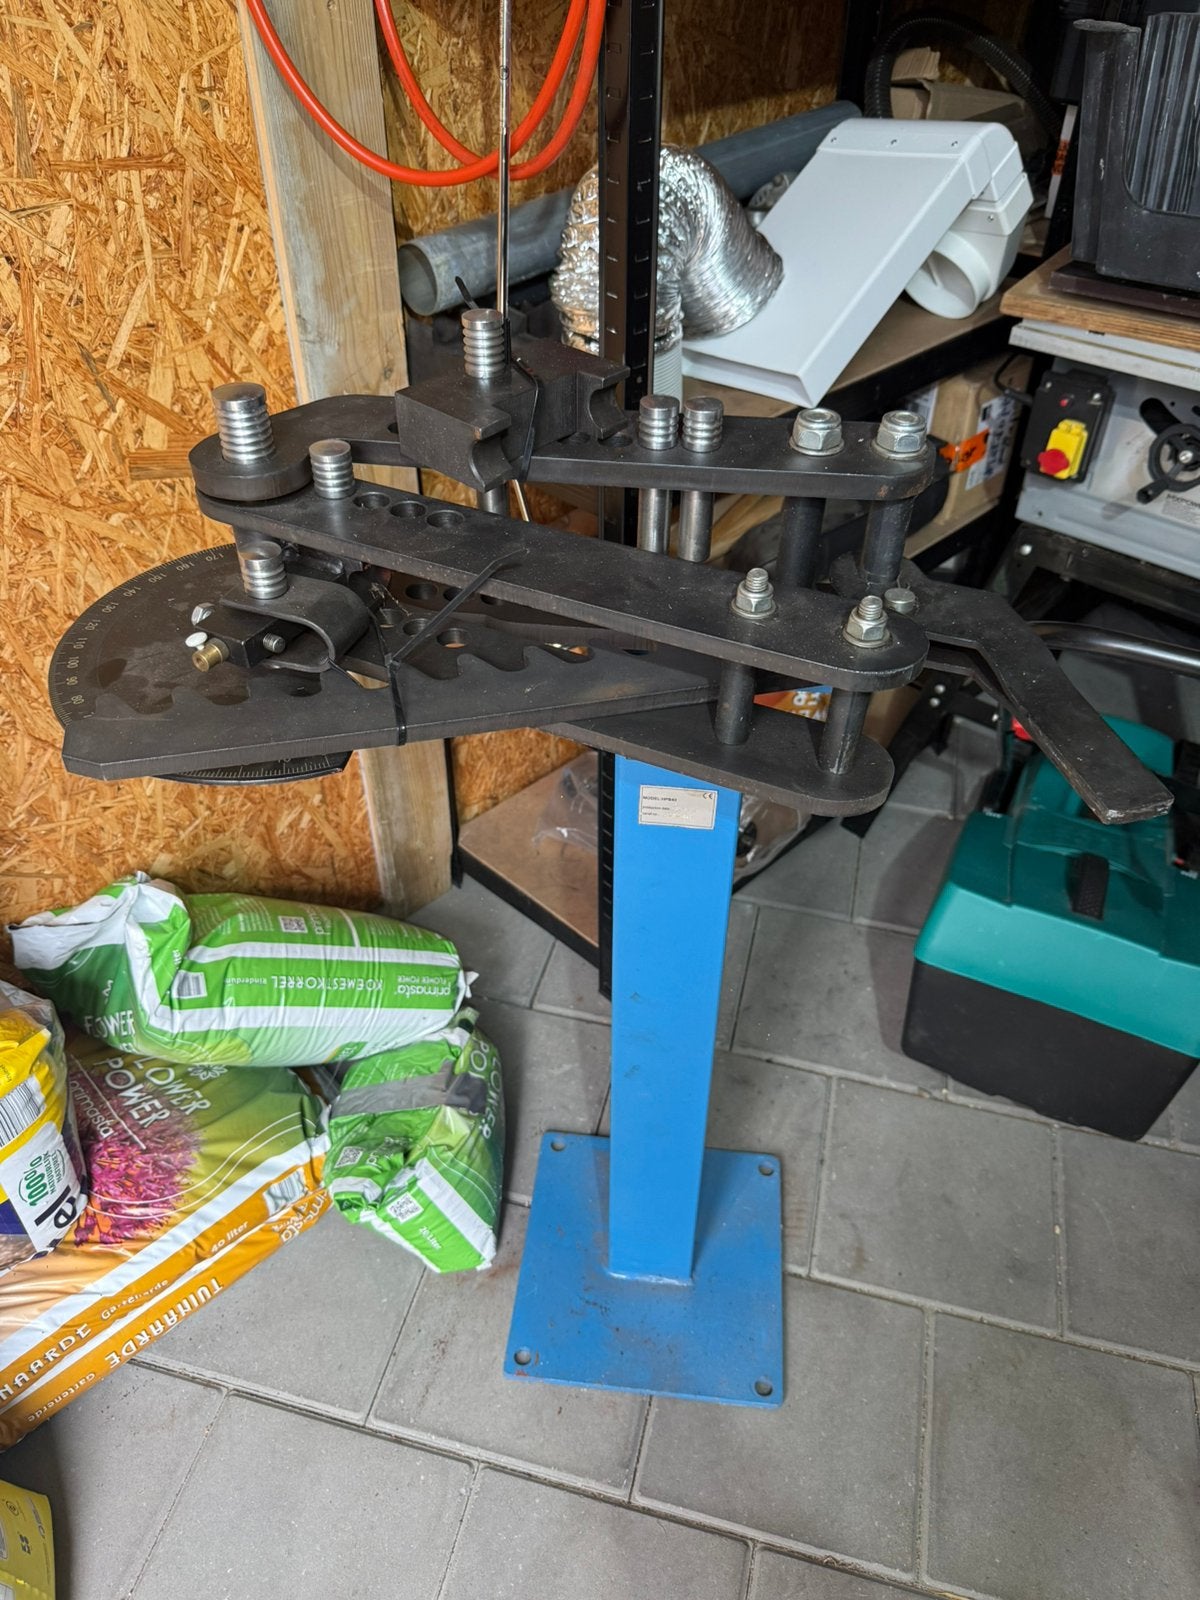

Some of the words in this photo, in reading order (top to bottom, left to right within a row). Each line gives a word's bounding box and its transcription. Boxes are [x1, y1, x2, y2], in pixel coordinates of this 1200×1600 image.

[122, 586, 142, 597] 140
[101, 602, 119, 614] 130
[84, 619, 101, 631] 120
[73, 637, 88, 650] 110
[66, 656, 80, 669] 100
[66, 675, 79, 686] 90
[71, 694, 85, 705] 80
[271, 975, 383, 991] KOEMESTKORREL
[397, 982, 452, 999] primasta
[93, 1056, 171, 1129] POWER
[133, 1055, 212, 1116] LOWER
[23, 1155, 49, 1207] 100%
[105, 1277, 225, 1369] TUINAARDE
[28, 1371, 97, 1422] Gartenerde
